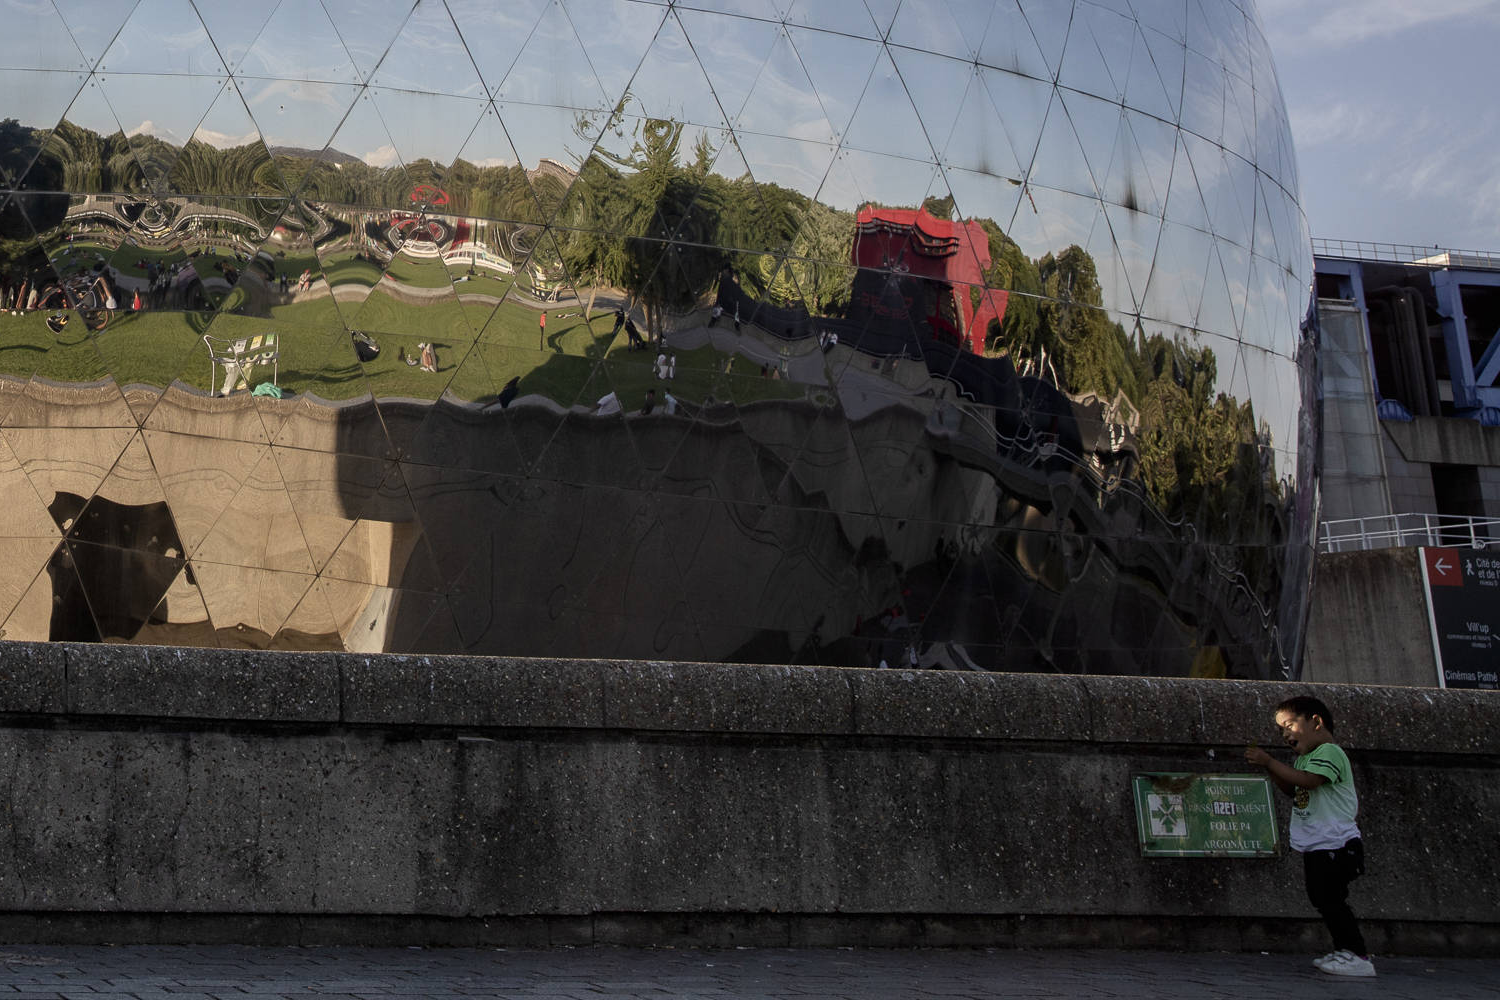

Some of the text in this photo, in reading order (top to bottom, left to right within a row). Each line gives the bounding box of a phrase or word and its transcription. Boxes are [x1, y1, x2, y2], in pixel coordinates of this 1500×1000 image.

[1445, 670, 1498, 682] Cinémas Pathé
[1204, 785, 1246, 795] POINT DE
[1210, 821, 1251, 831] FOLIE P4
[1204, 840, 1263, 849] ARGONAUTE
